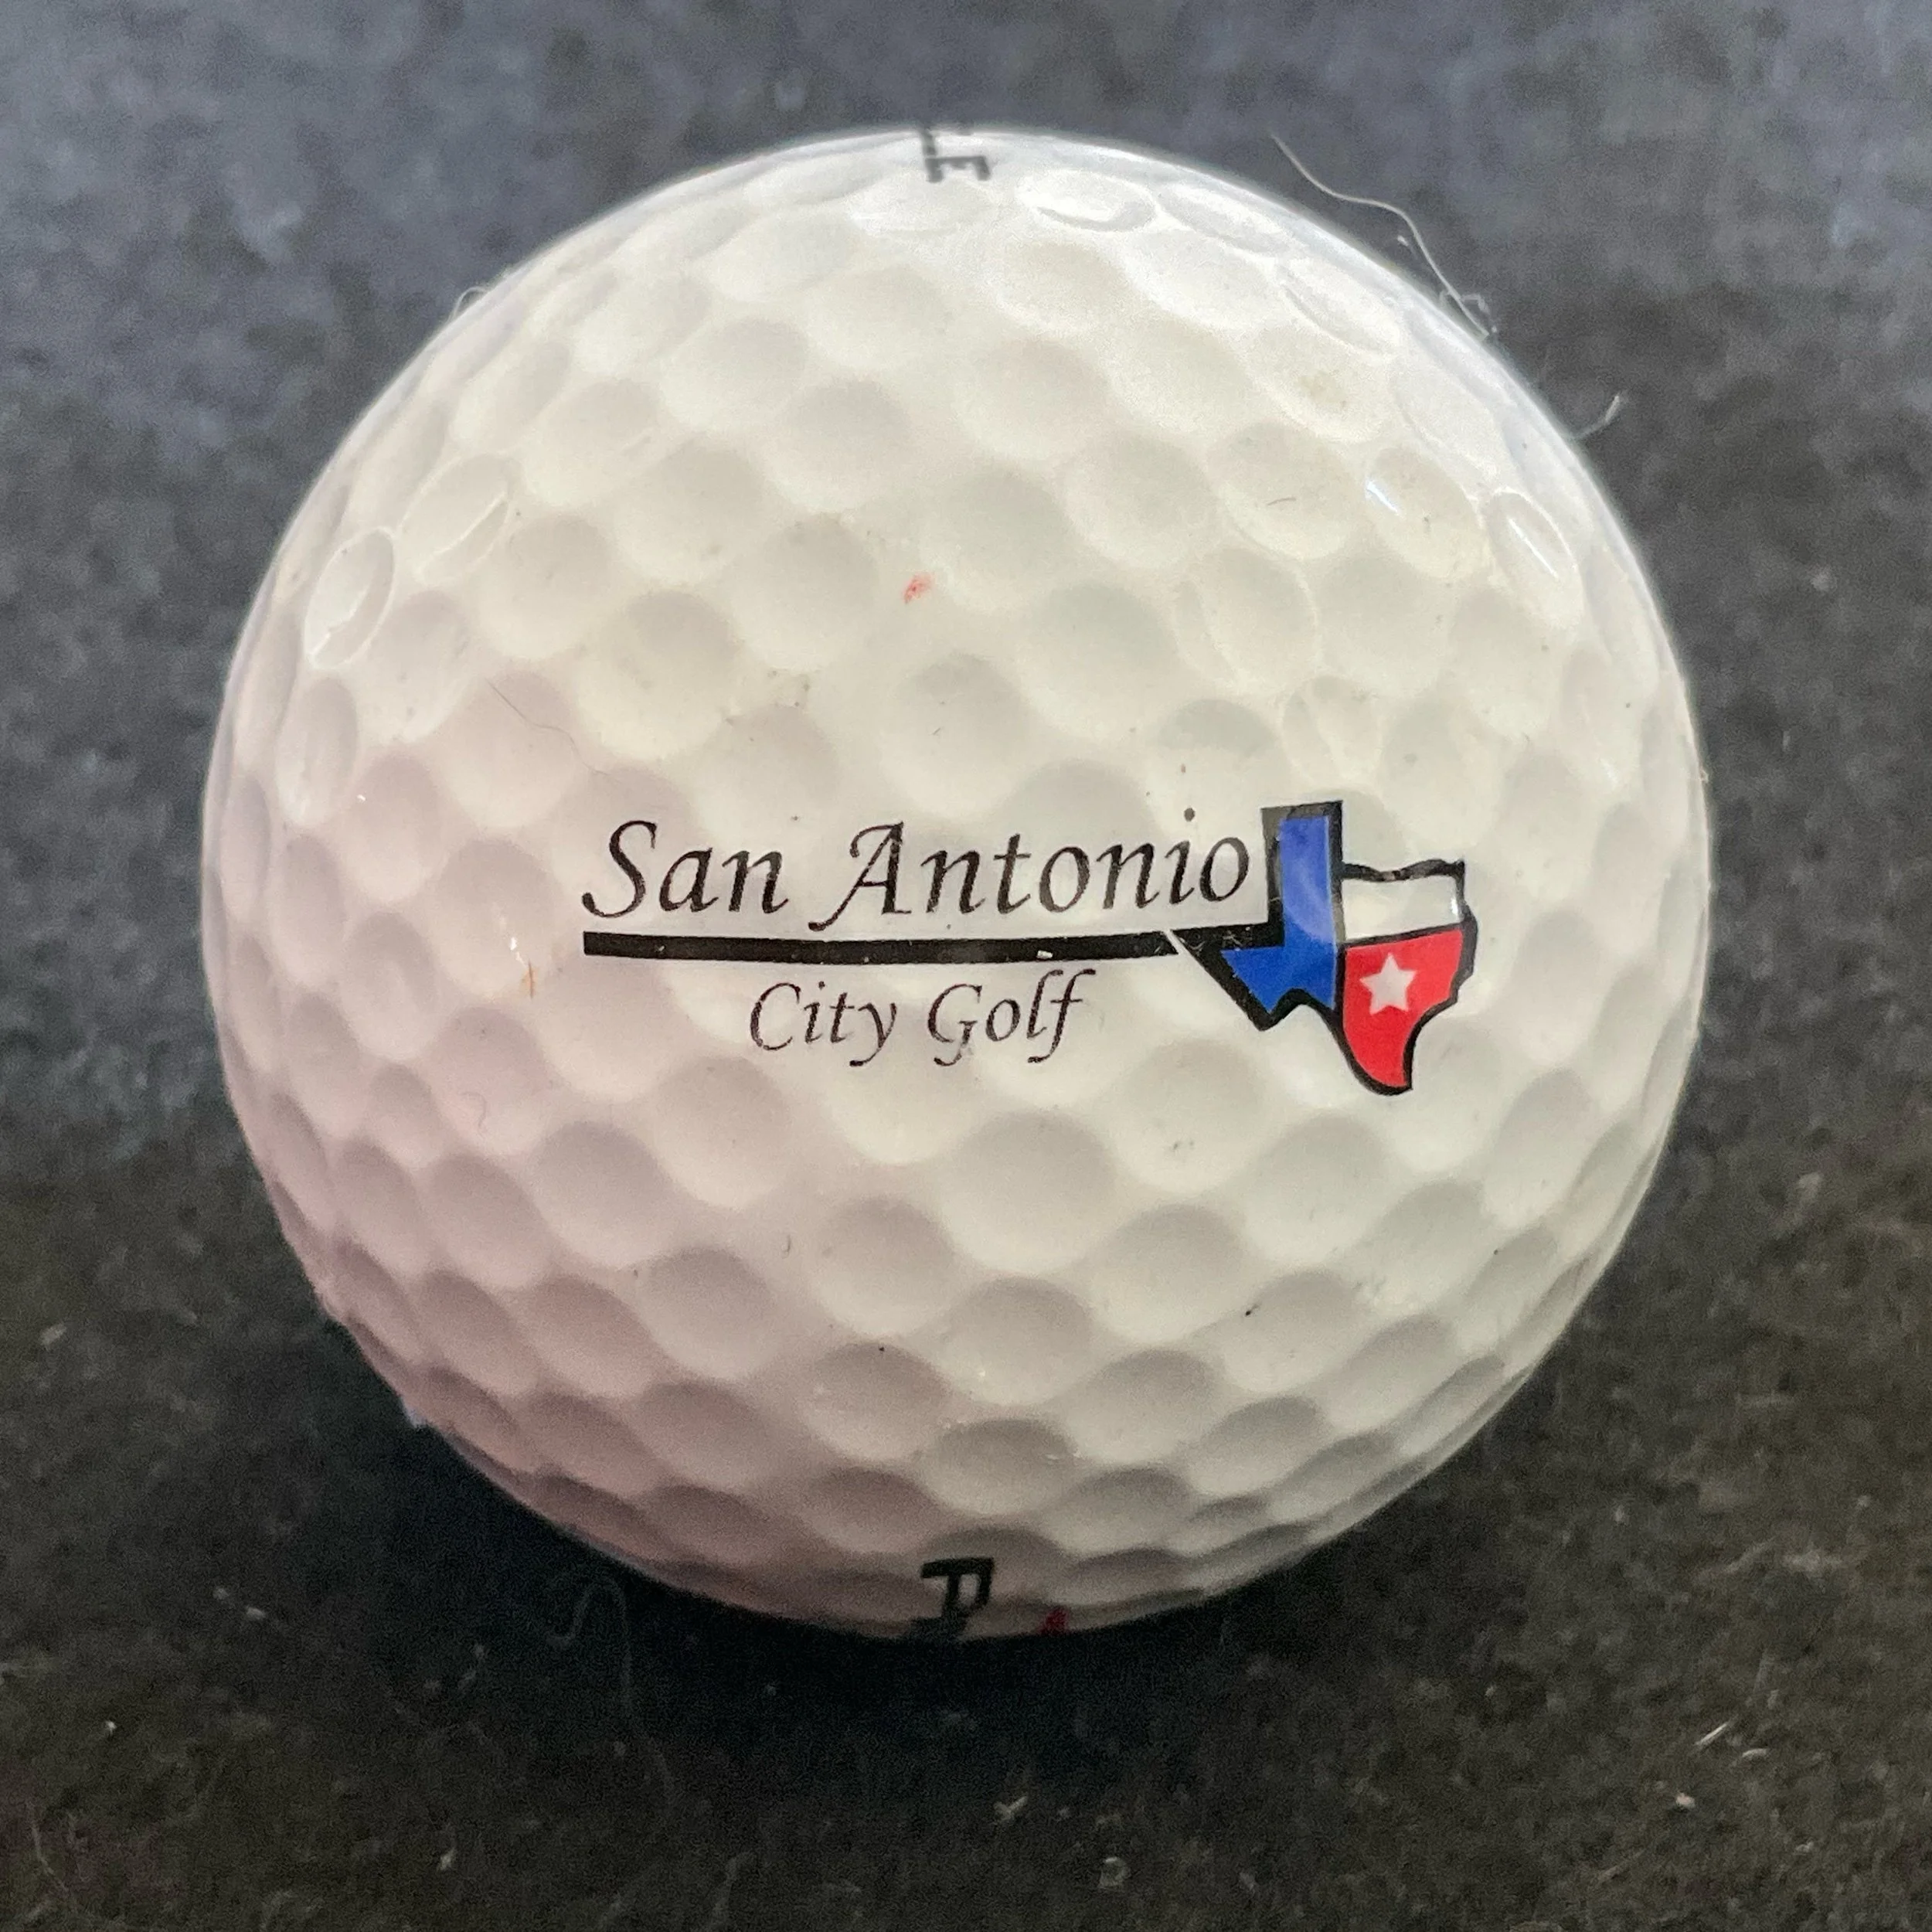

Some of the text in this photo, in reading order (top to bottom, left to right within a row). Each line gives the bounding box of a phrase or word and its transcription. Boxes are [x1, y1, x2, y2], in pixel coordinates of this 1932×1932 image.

[581, 807, 1250, 932] San Antonio
[750, 968, 1097, 1067] City Golf
